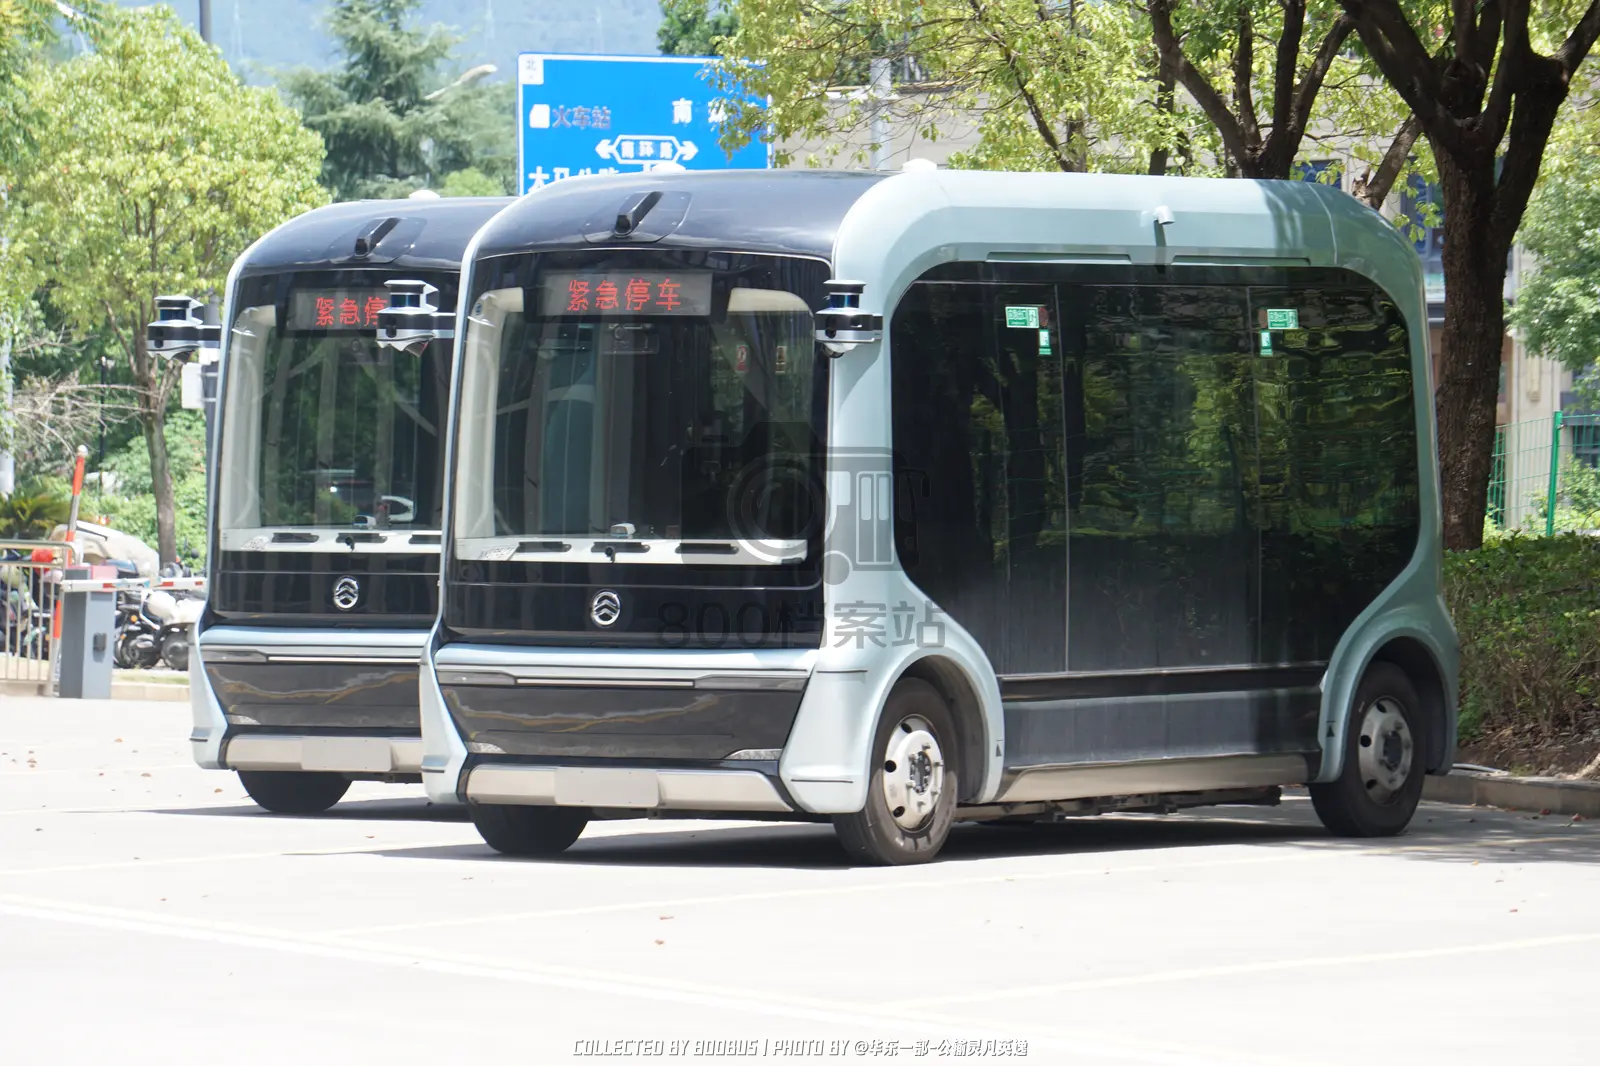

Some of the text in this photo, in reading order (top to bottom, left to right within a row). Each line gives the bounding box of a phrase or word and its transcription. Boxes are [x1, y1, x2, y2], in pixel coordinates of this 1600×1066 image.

[552, 104, 612, 129] 火车站
[567, 278, 681, 311] 紧急停车
